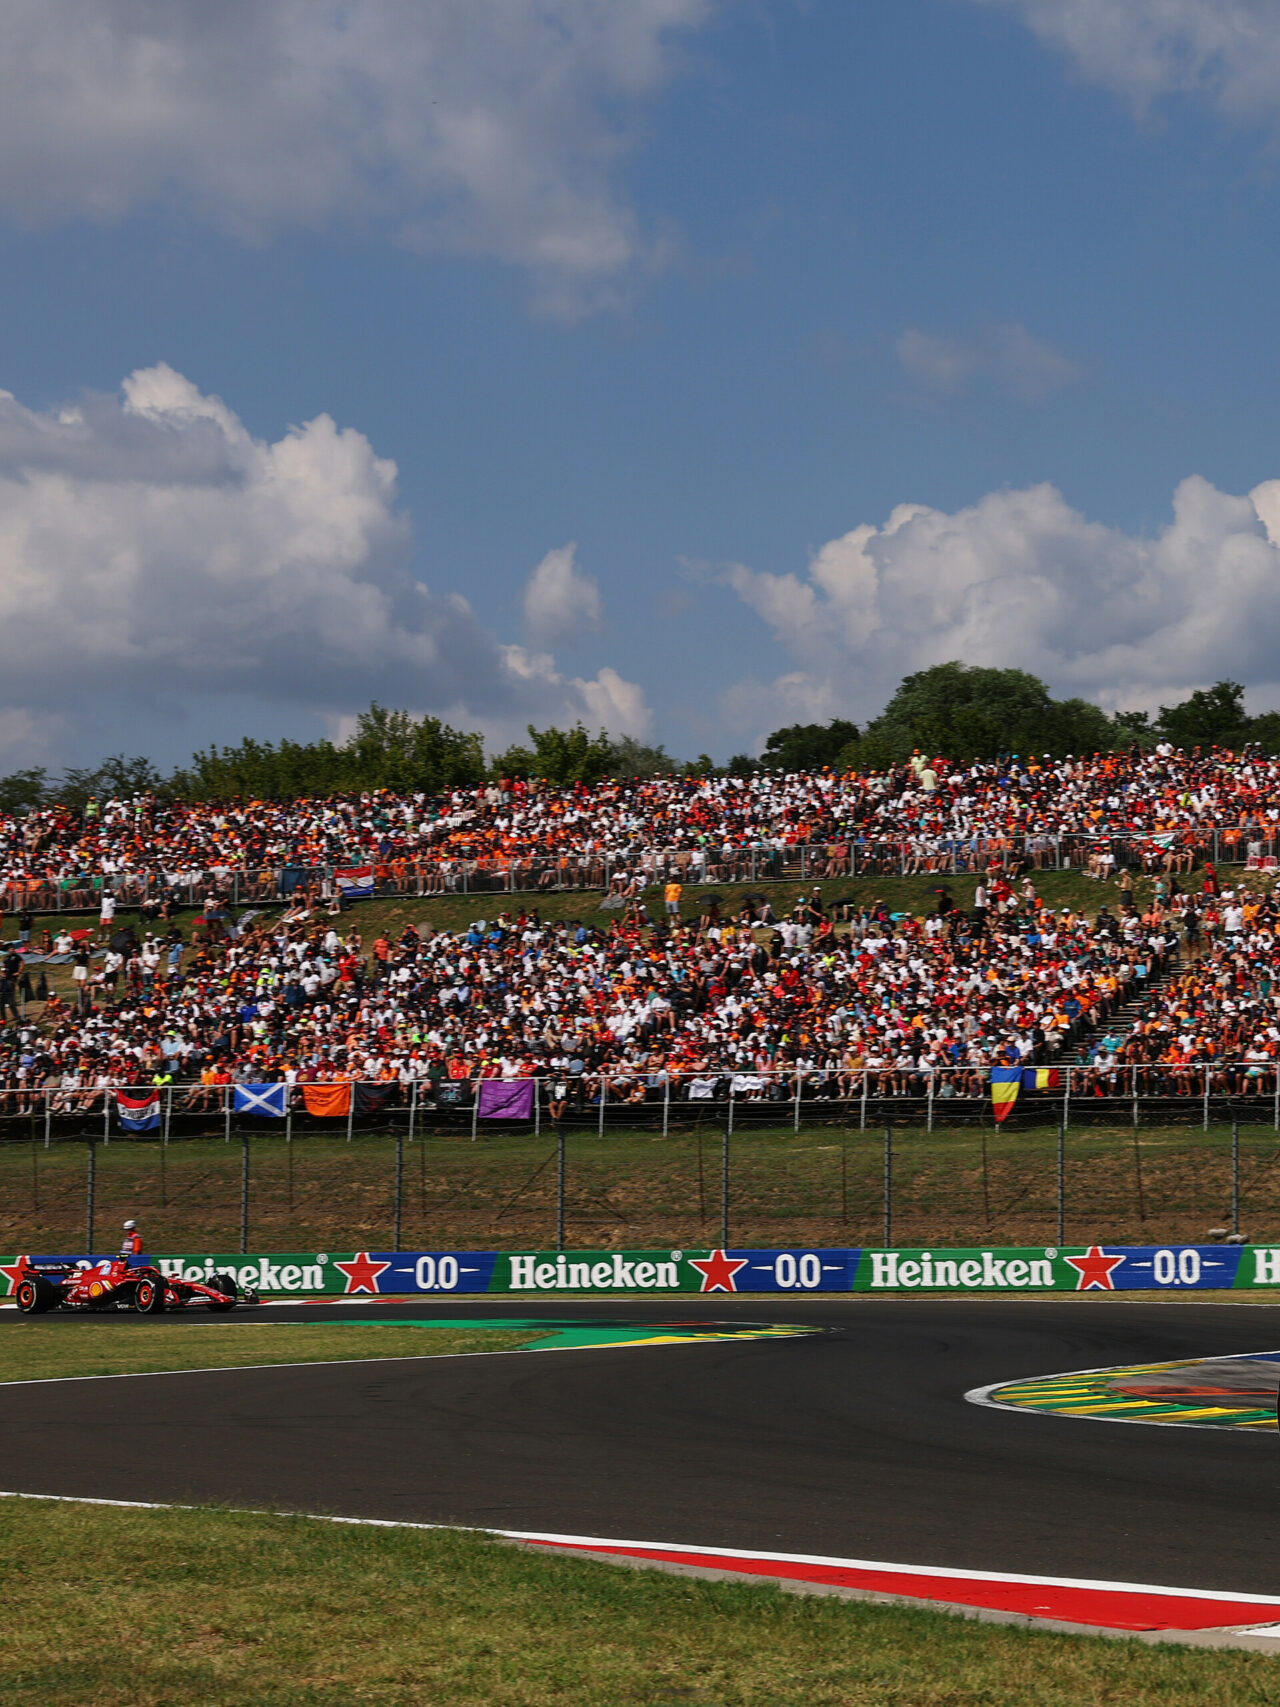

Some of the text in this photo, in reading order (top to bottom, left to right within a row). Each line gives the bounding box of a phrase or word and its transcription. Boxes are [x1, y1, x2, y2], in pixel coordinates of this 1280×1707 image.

[416, 1256, 458, 1289] 0.0
[509, 1255, 680, 1288] Heineken
[775, 1254, 821, 1287] 0.0
[870, 1252, 1056, 1287] Heineken
[1154, 1249, 1200, 1284] 0.0
